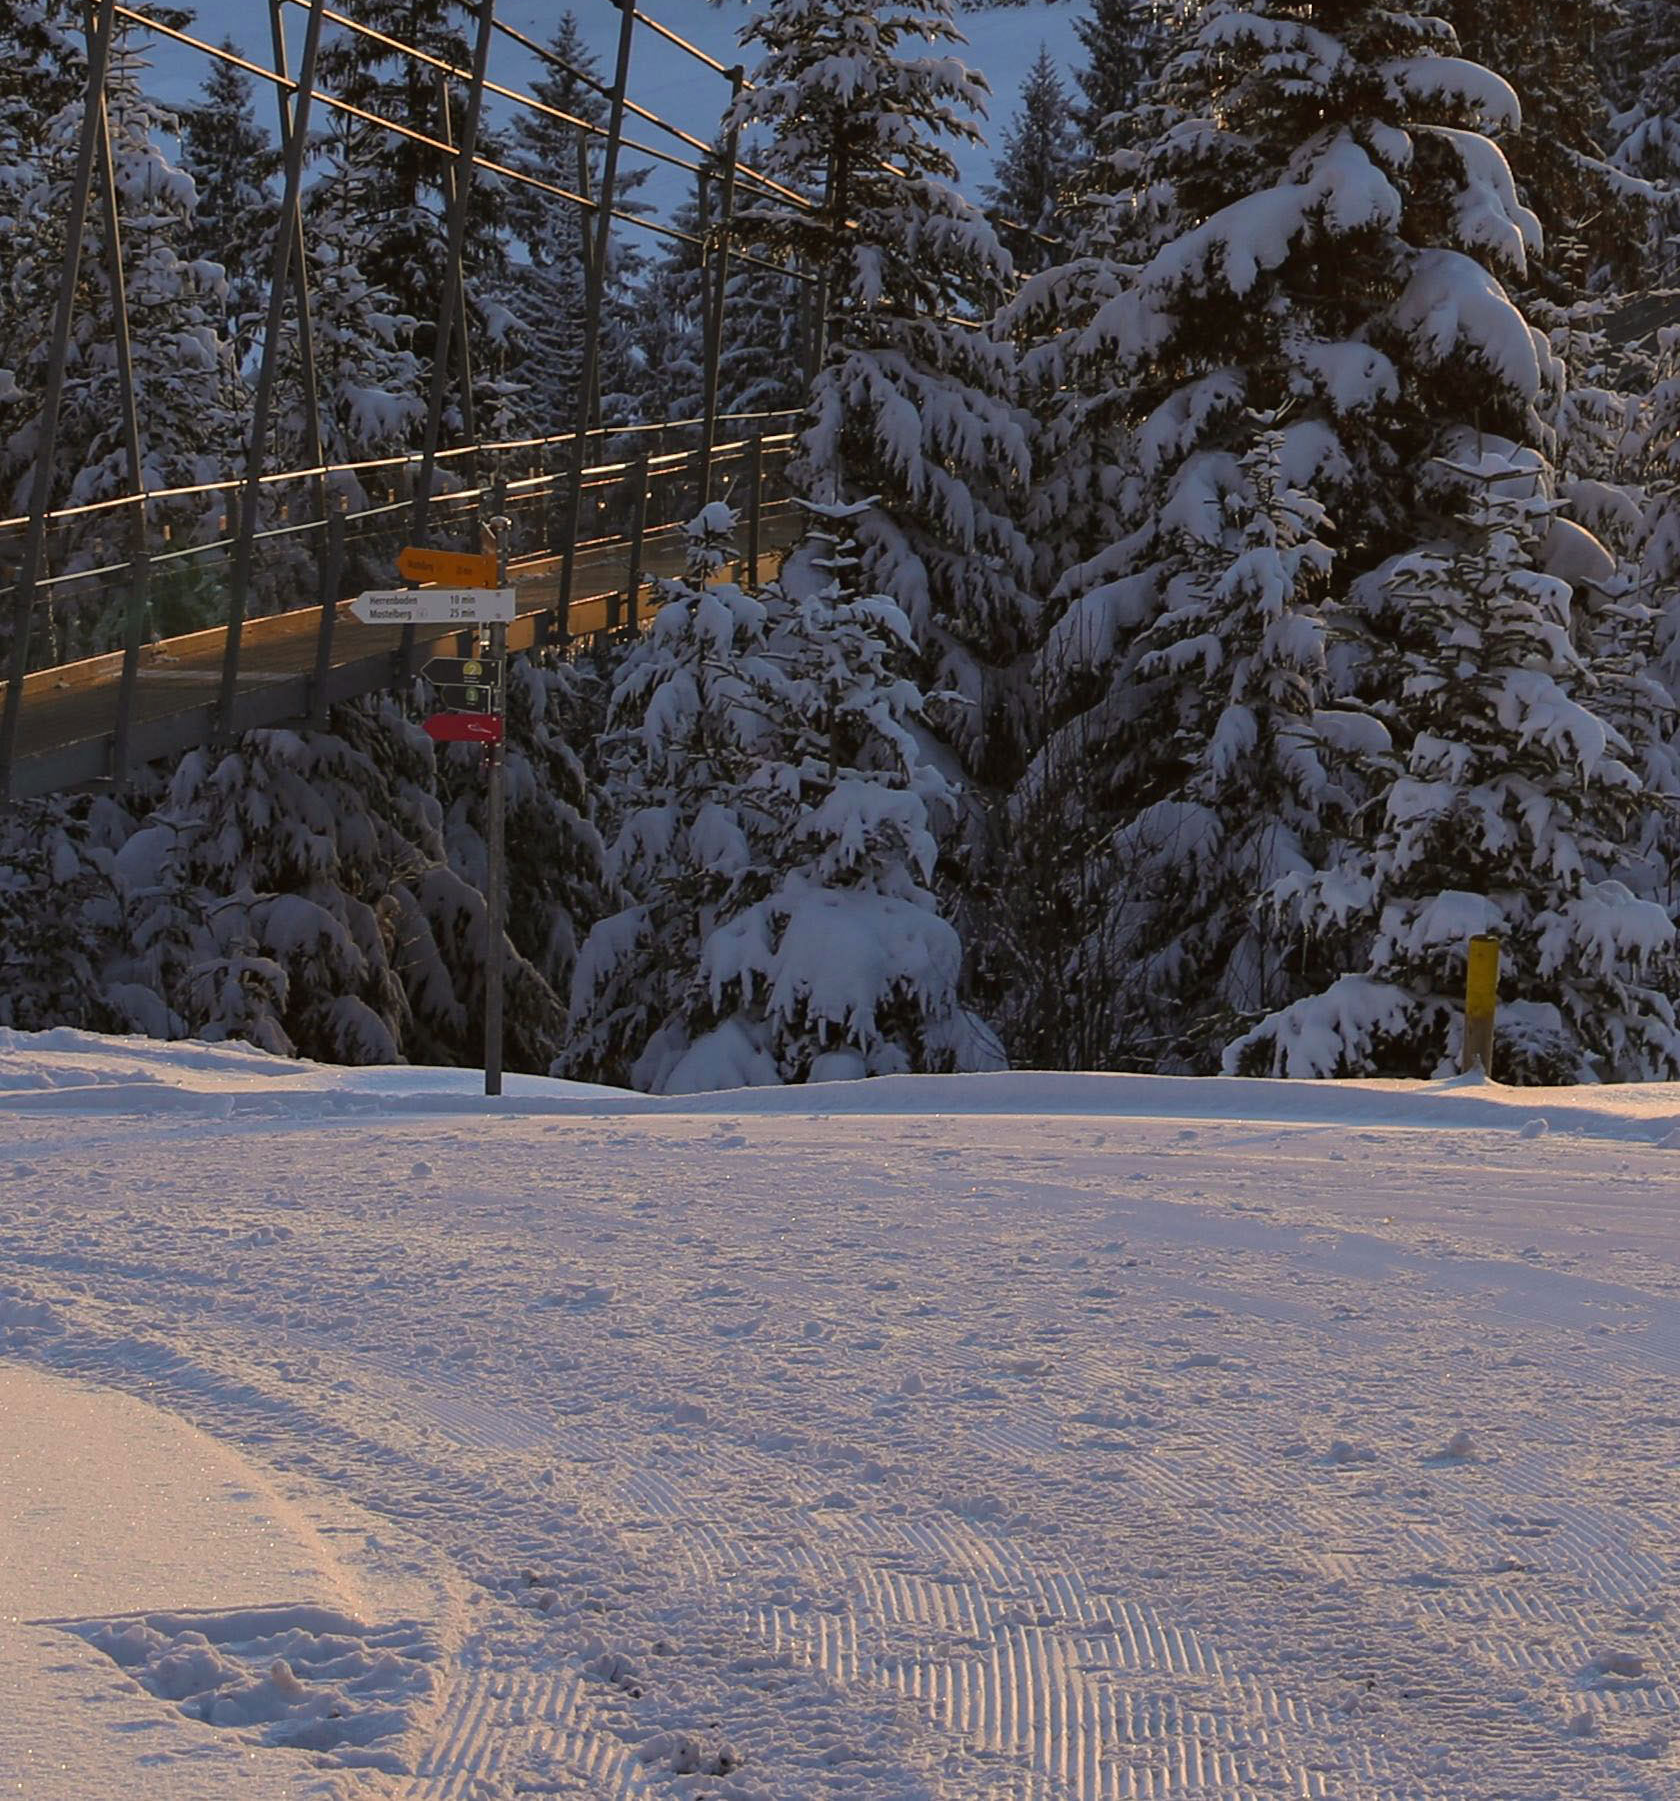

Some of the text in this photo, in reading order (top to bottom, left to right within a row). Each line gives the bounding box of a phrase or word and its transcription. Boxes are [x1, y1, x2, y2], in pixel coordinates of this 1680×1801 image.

[369, 595, 418, 606] Herrenboden
[461, 595, 476, 605] min
[369, 608, 476, 621] Mostelberg 25 min
